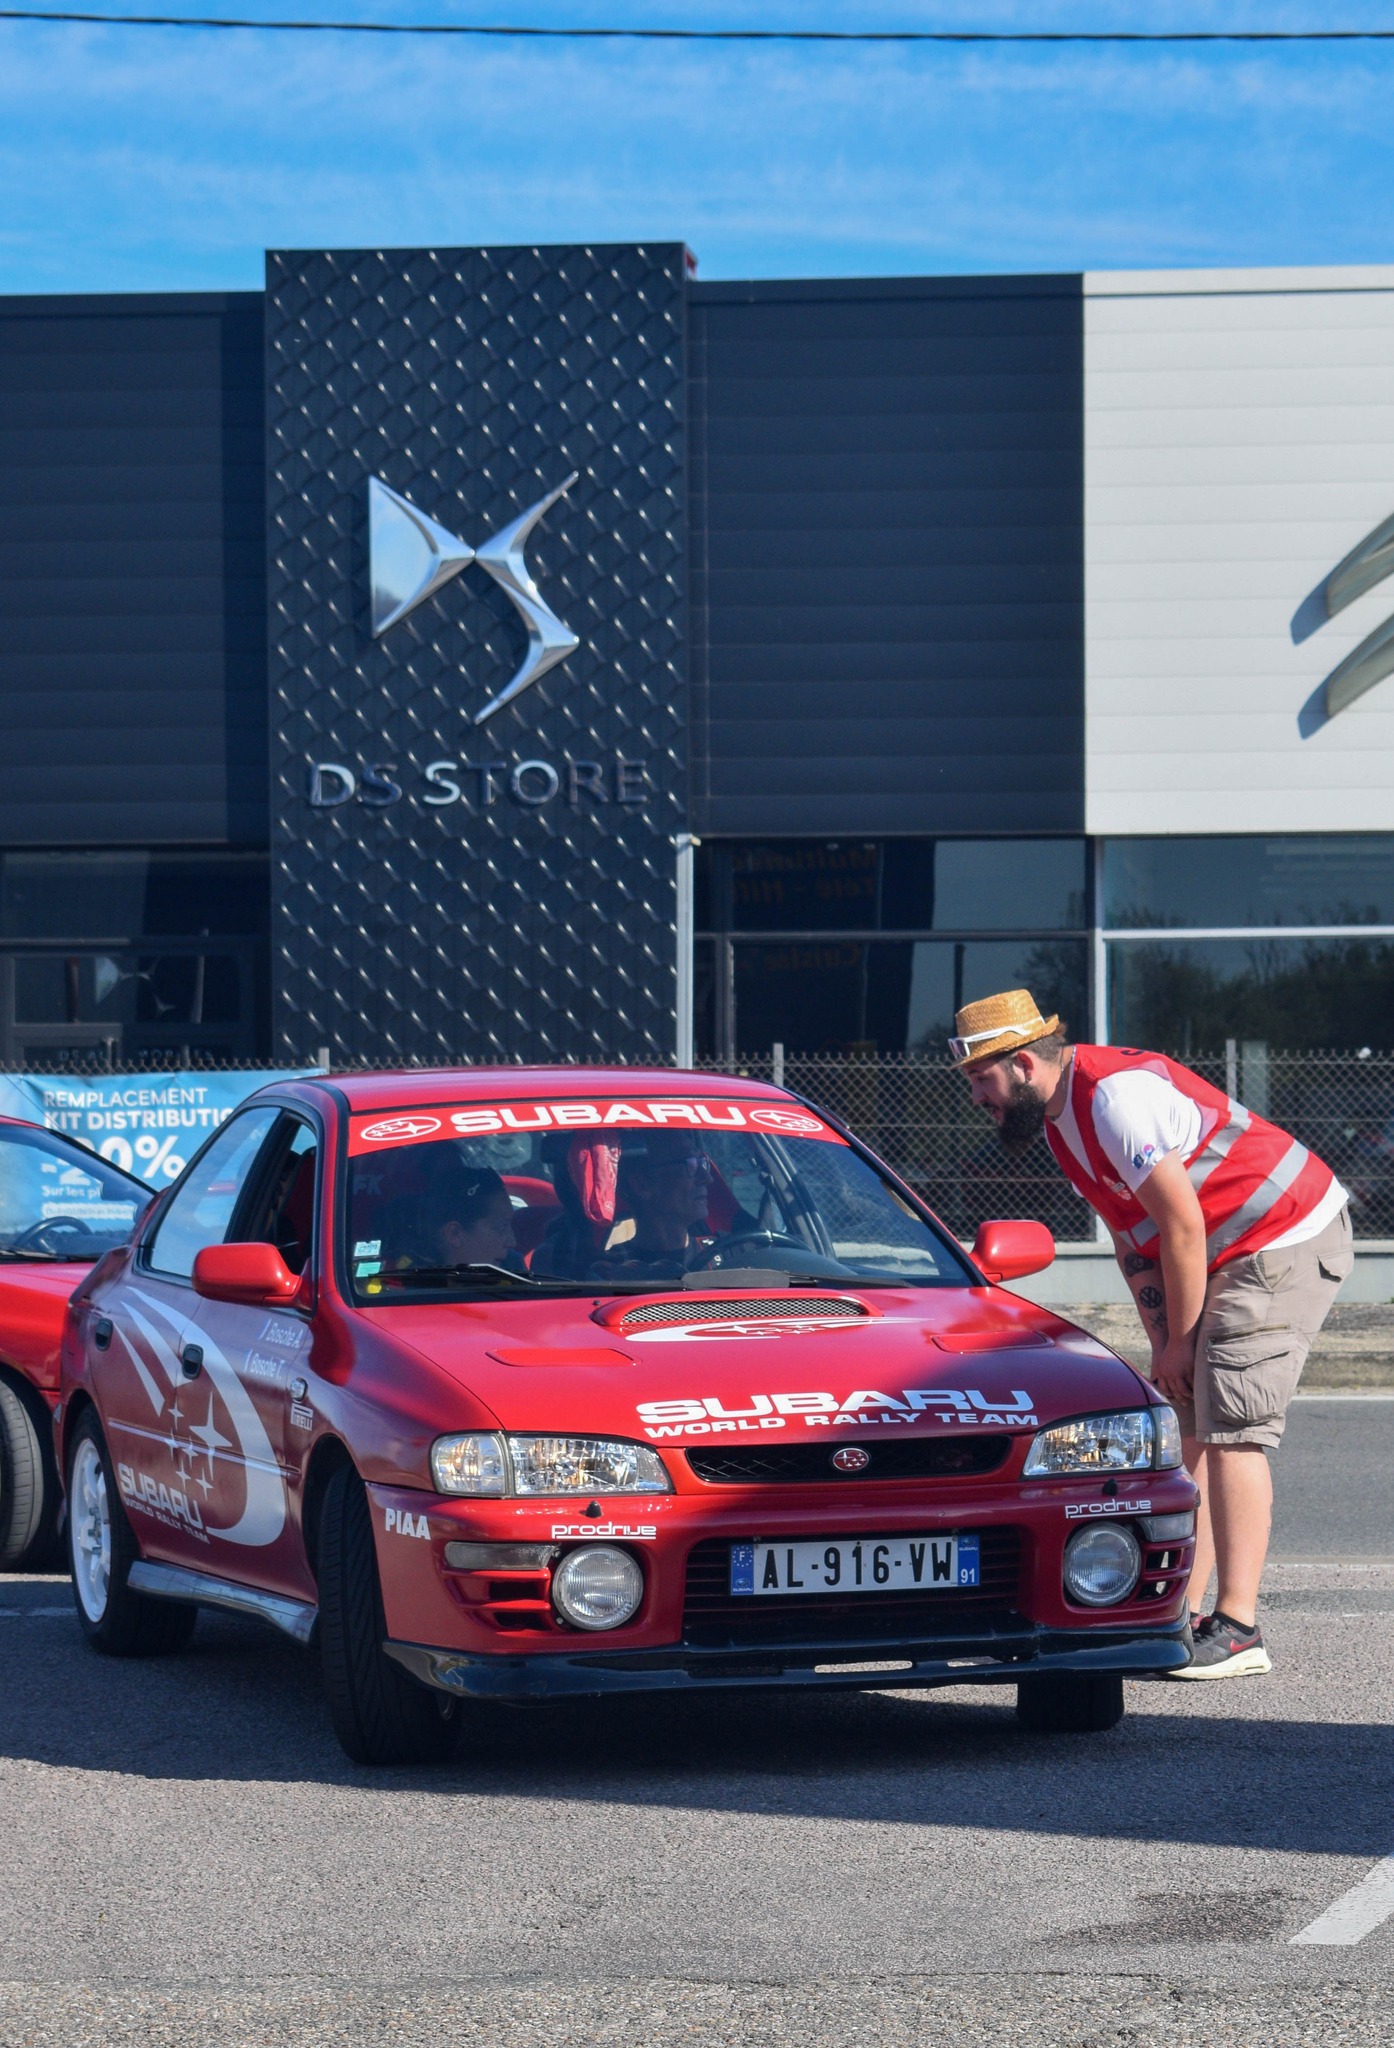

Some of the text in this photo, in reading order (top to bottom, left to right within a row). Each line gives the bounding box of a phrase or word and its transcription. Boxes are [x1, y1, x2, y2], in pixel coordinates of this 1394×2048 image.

[309, 760, 648, 806] DS STORE
[44, 1088, 208, 1108] REMPLACEMENT
[44, 1111, 82, 1130] KIT
[451, 1104, 747, 1132] SUBARU
[291, 1402, 314, 1431] PIRELLI
[636, 1390, 1034, 1424] SUBARU
[643, 1412, 1038, 1439] WORLD RALLY TEAM
[118, 1462, 203, 1530] SUBARU
[1065, 1499, 1151, 1518] prodrive
[123, 1496, 211, 1545] WORLD RALLY TEAM
[385, 1507, 431, 1540] PIAA
[551, 1522, 657, 1539] prodrive
[739, 1551, 746, 1562] F
[762, 1542, 952, 1588] AL-916-VW
[960, 1568, 975, 1583] 91
